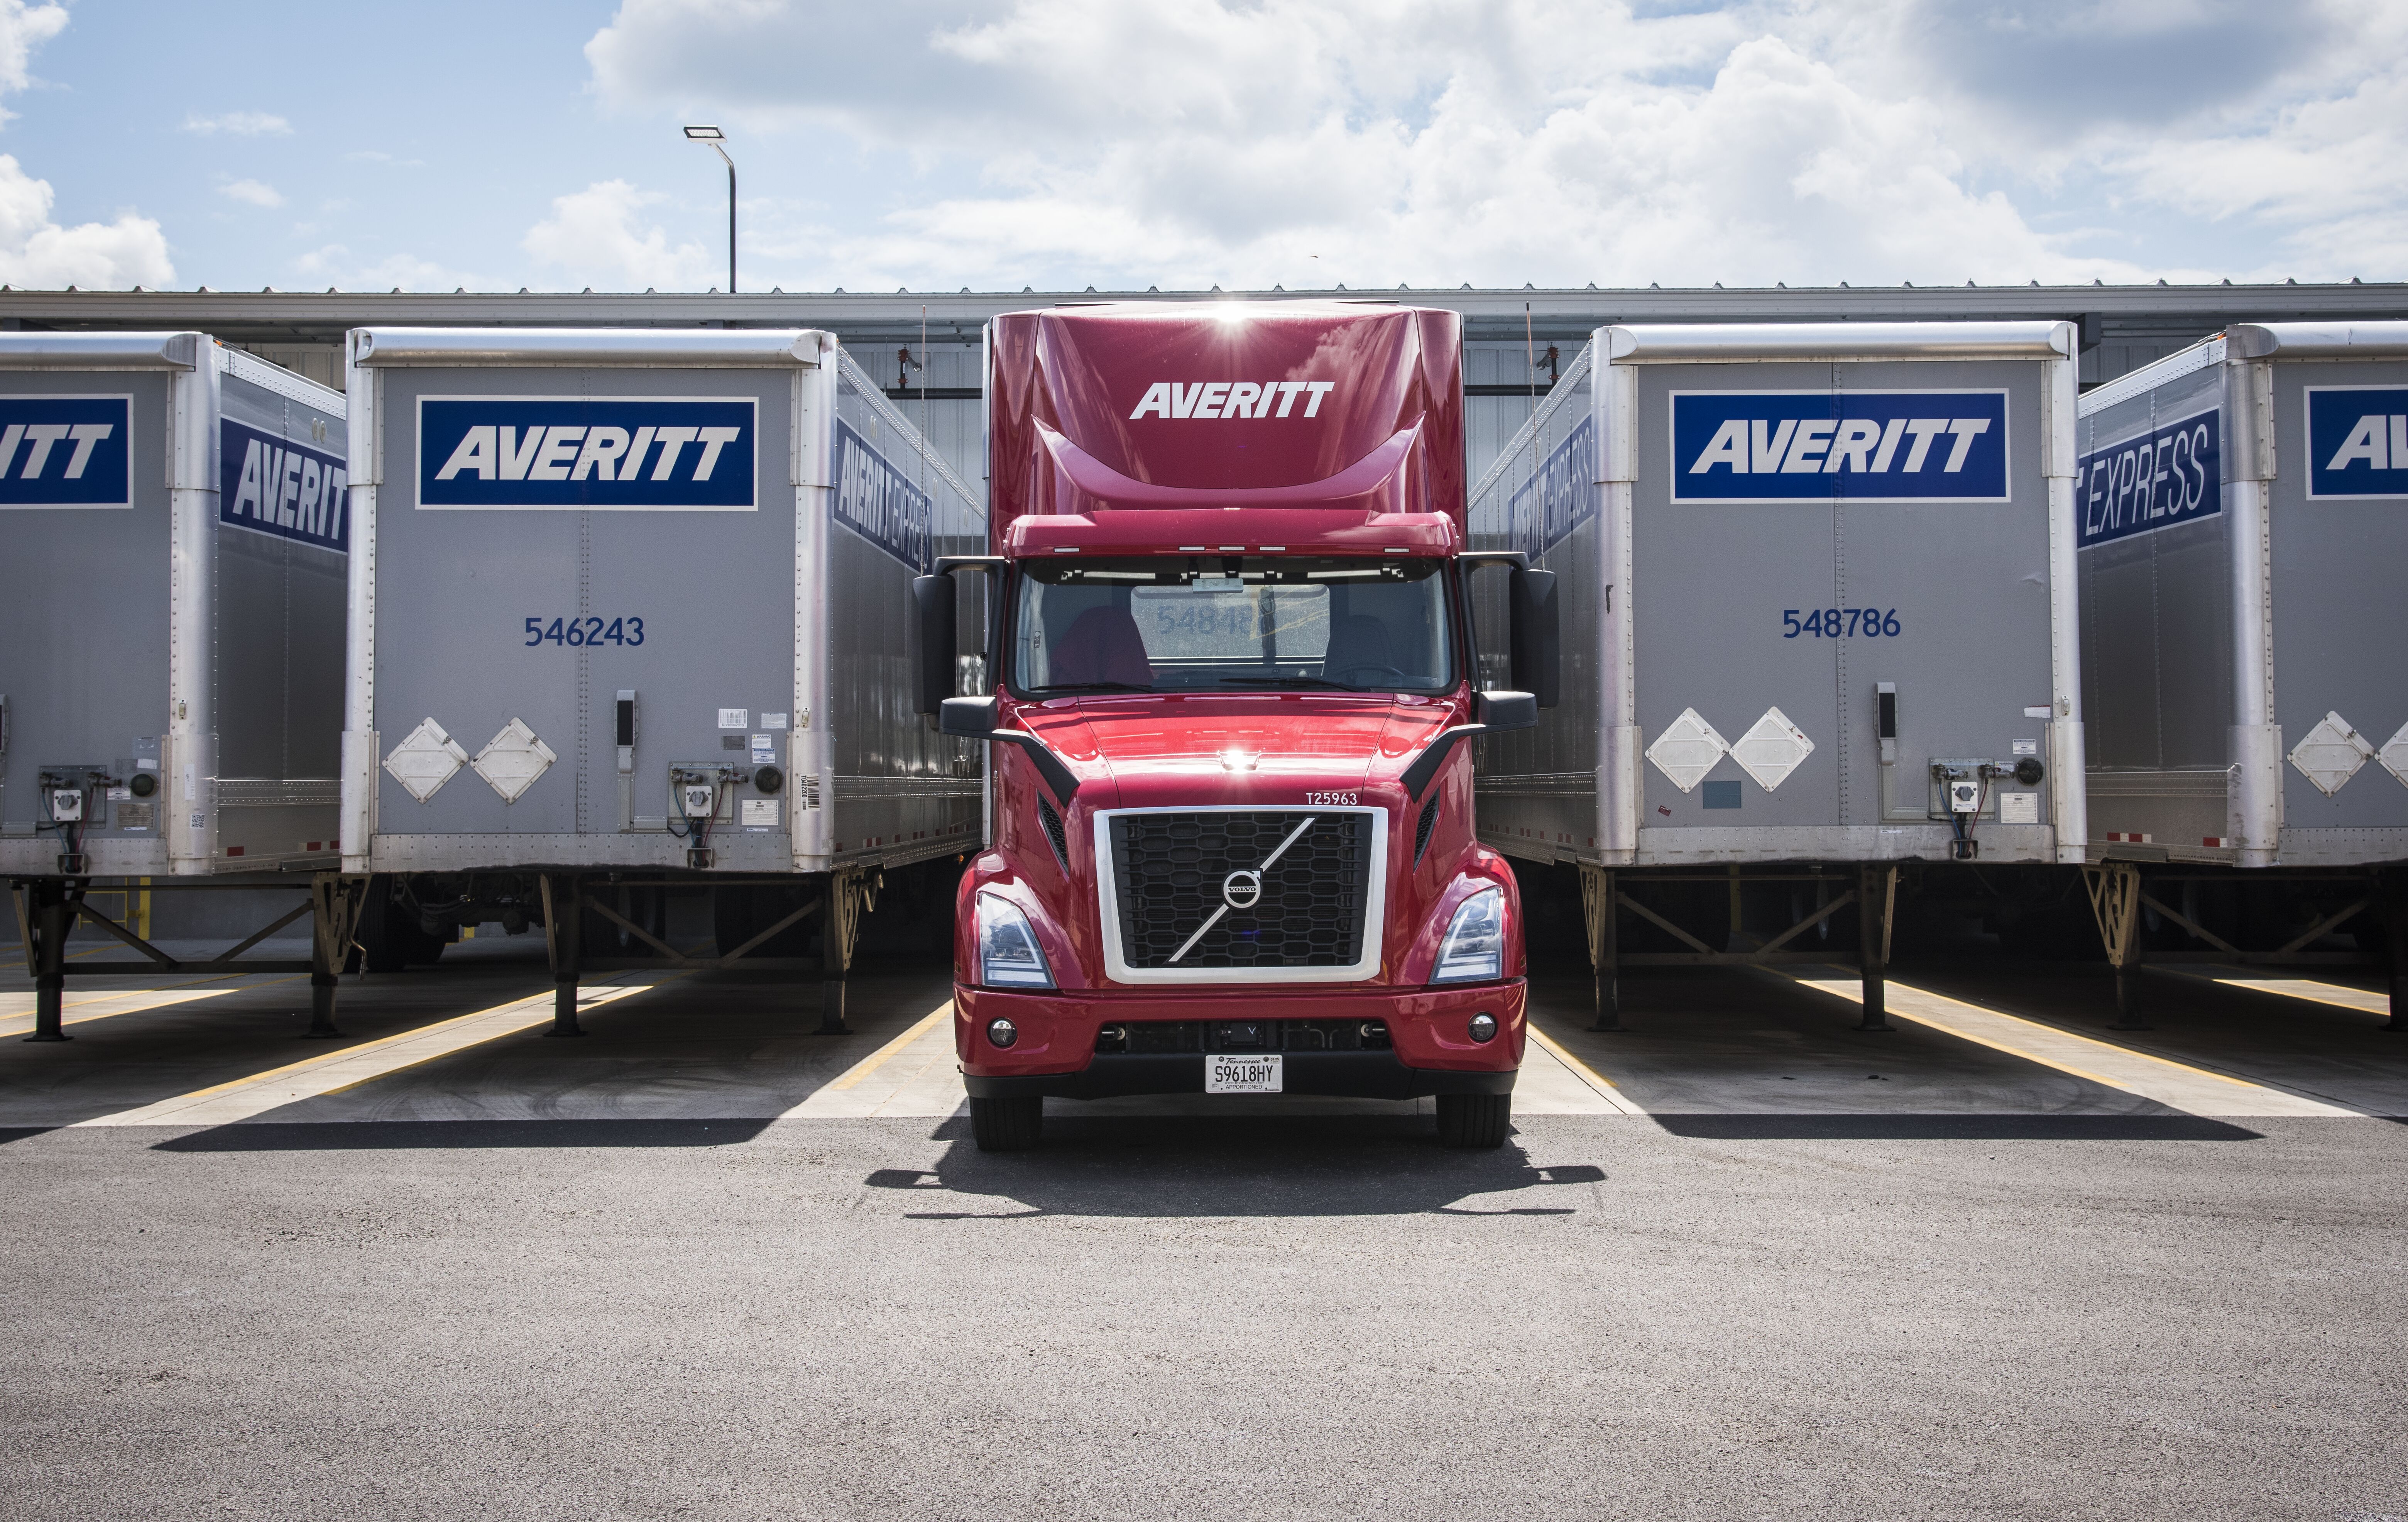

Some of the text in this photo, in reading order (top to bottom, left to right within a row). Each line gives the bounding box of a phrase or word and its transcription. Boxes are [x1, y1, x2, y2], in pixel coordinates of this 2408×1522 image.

[1129, 381, 1335, 420] AVERITT
[435, 426, 741, 481] AVERITT
[1688, 418, 1991, 474] AVERITT
[838, 435, 892, 541] AVERITT
[1547, 426, 1590, 540] EXPRESS
[2085, 423, 2208, 537] EXPRESS
[524, 616, 644, 646] 546243
[1783, 608, 1901, 638] 548786
[1306, 792, 1357, 805] T25963
[1215, 1065, 1273, 1082] S9618HY
